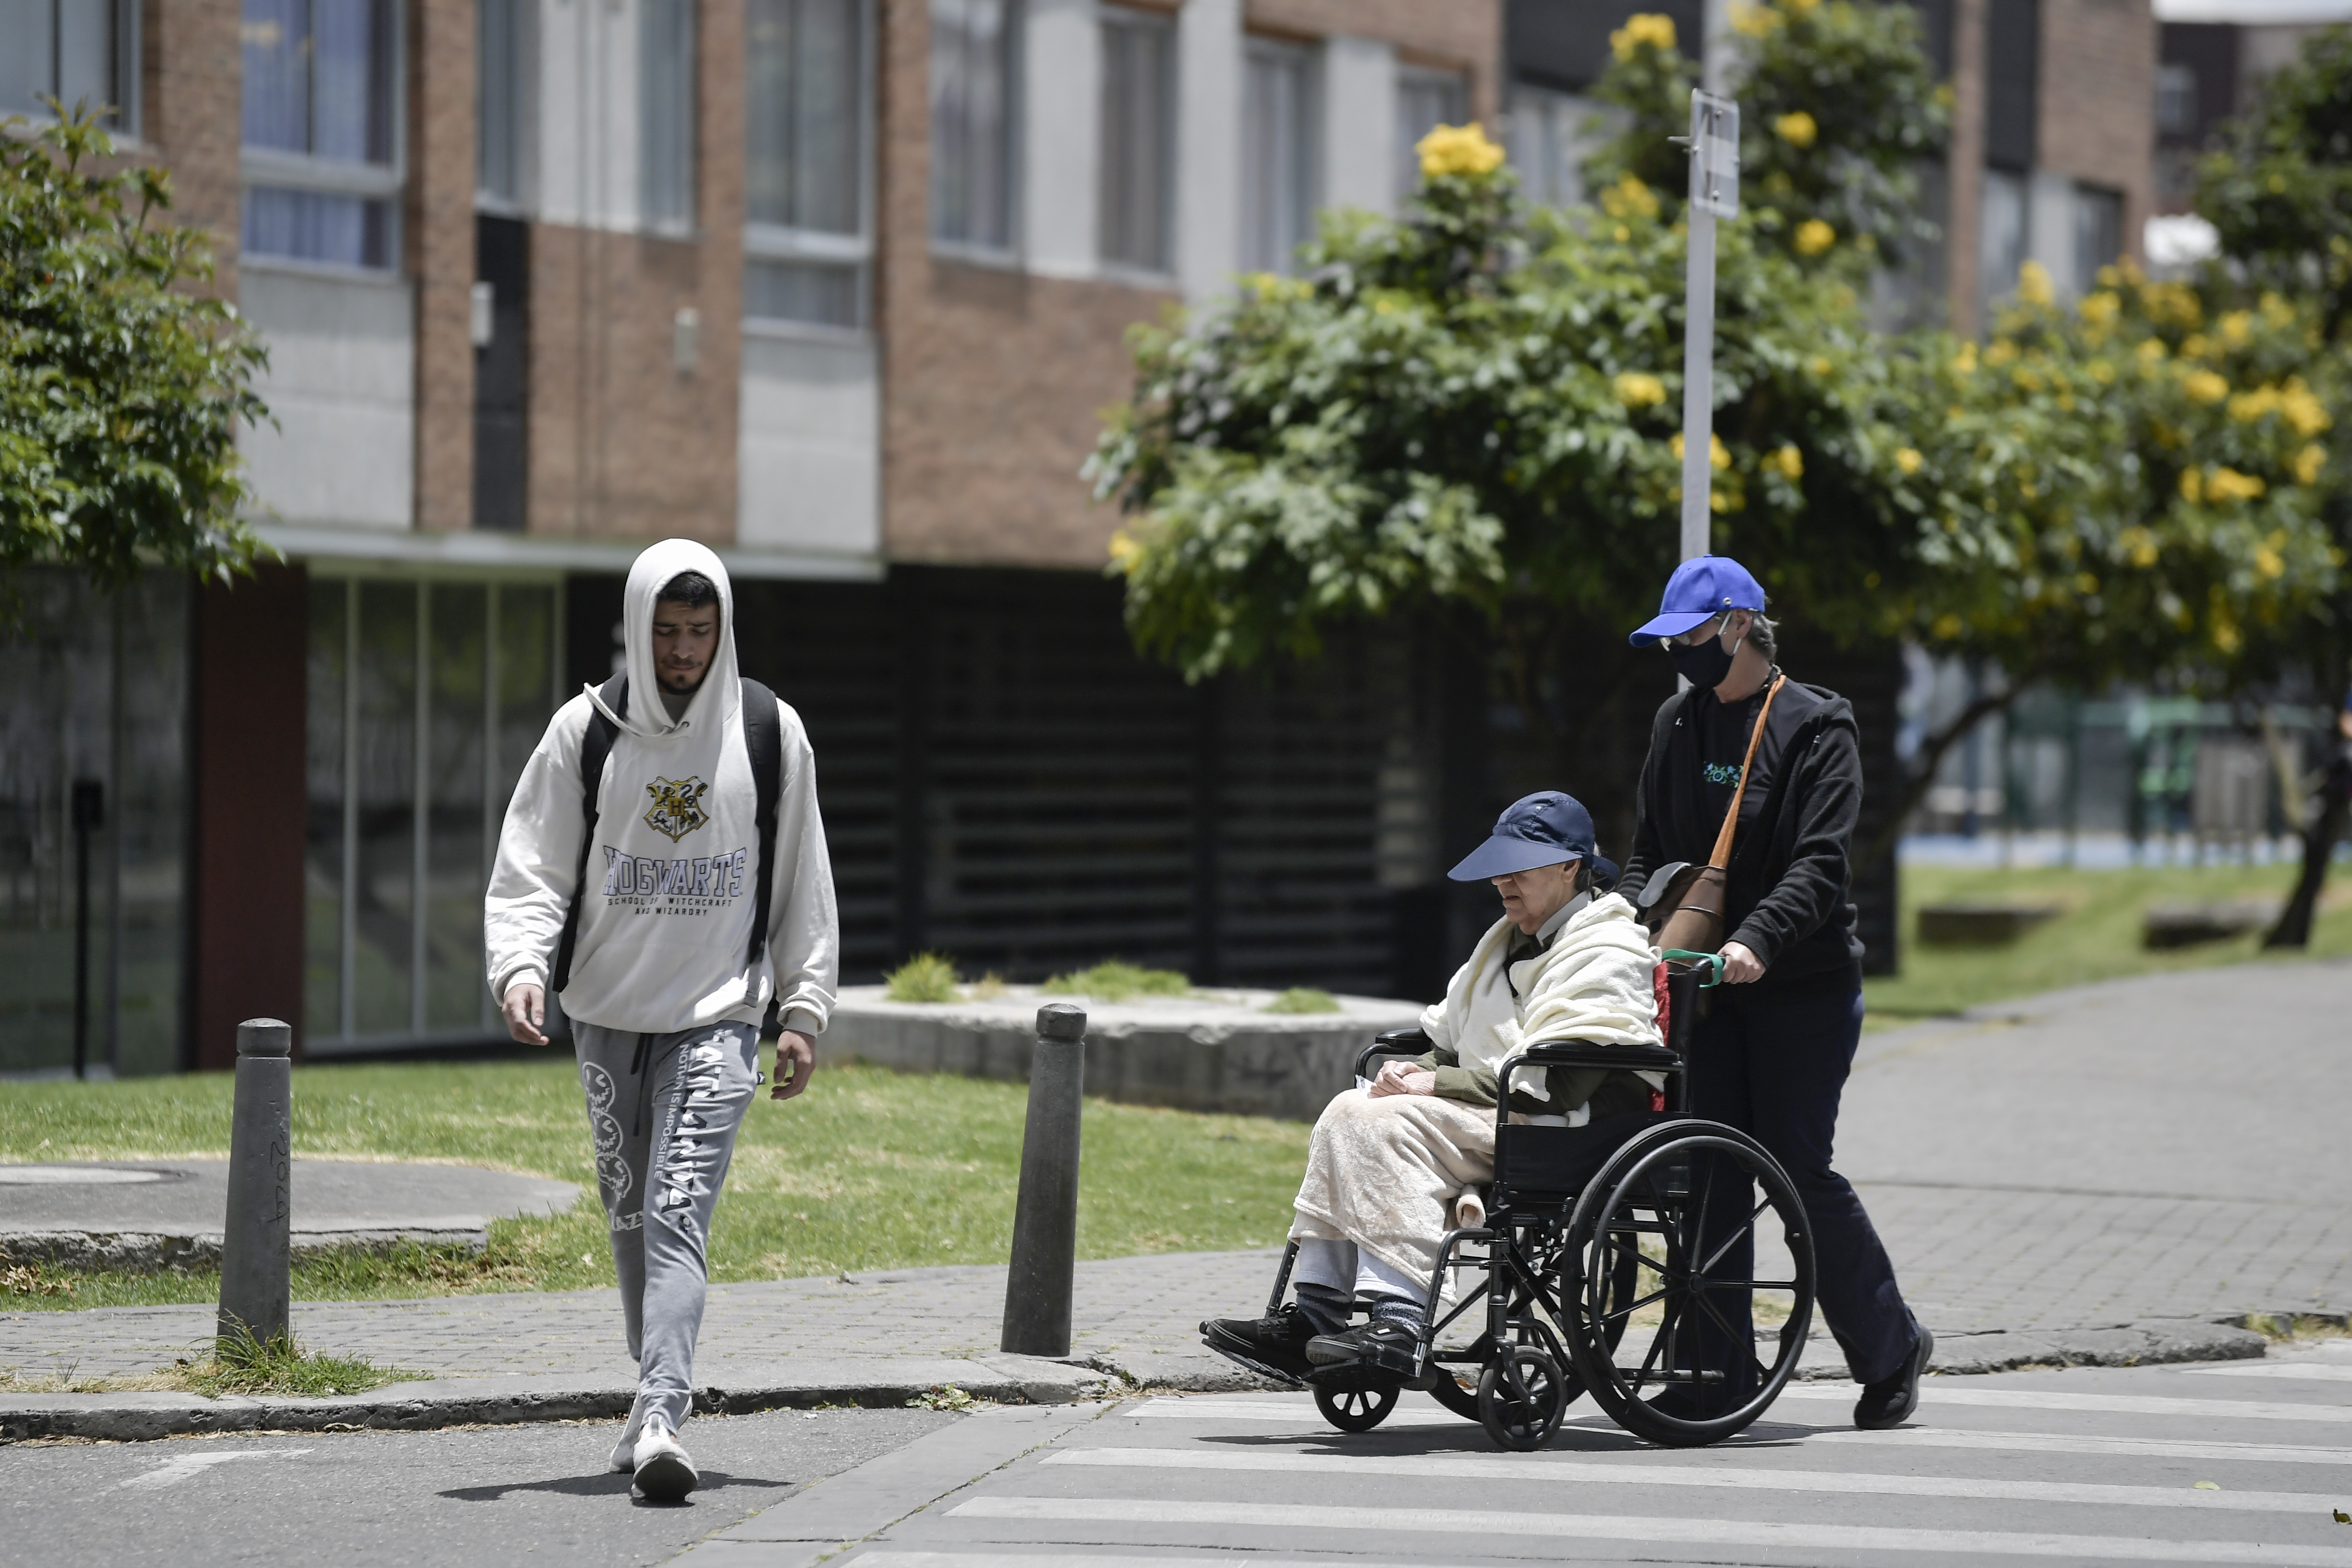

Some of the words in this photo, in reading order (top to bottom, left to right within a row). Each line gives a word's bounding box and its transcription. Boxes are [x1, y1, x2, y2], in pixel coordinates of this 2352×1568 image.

[670, 800, 682, 814] H
[603, 845, 747, 897] HOGWARTS
[608, 897, 645, 906] SCHOOL
[668, 897, 732, 907] WITCHCRAFT
[655, 907, 707, 916] WIZARDRY
[671, 1092, 681, 1104] IS
[654, 1104, 677, 1178] IMPOSSIBLE
